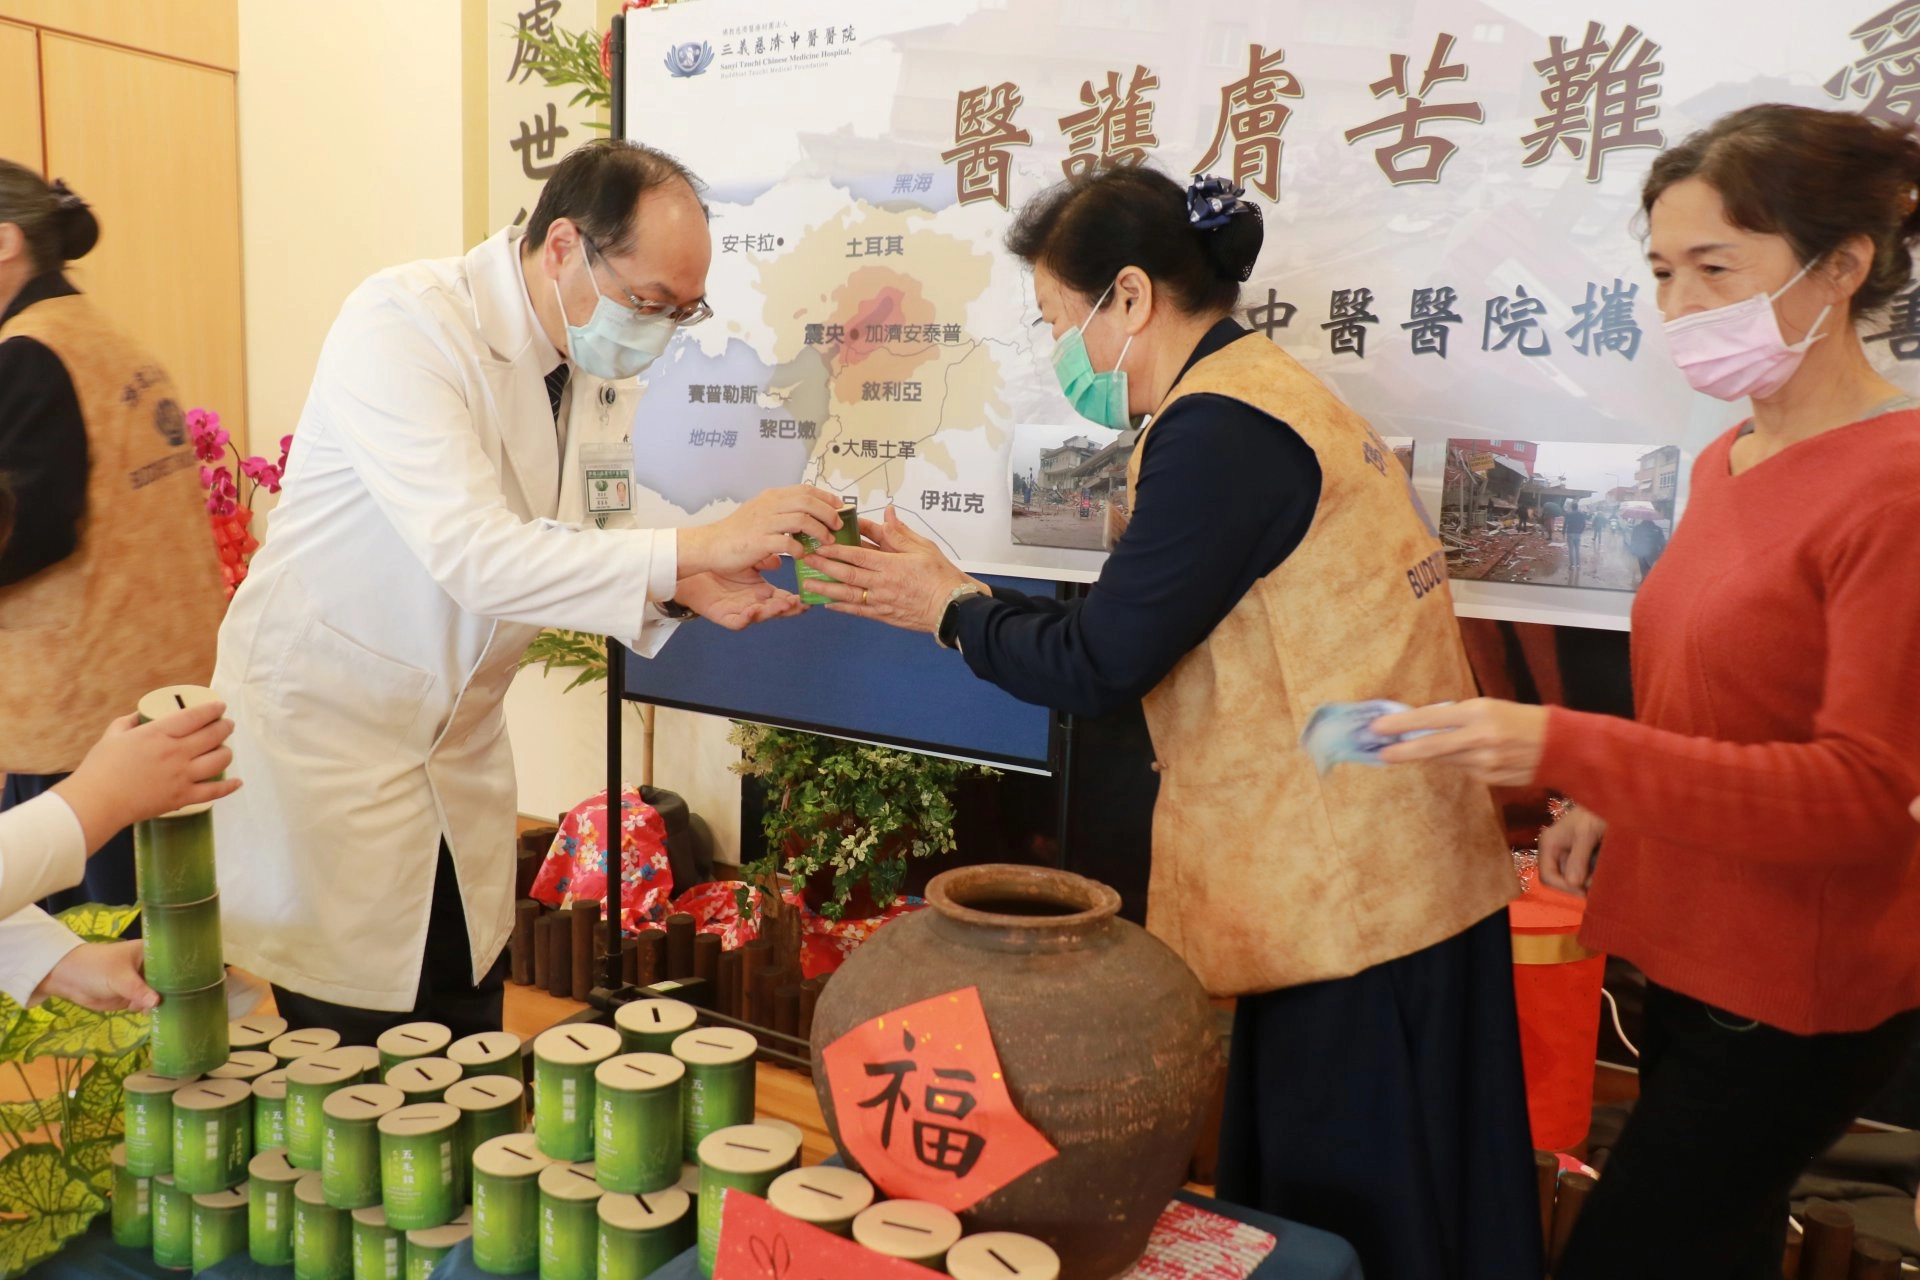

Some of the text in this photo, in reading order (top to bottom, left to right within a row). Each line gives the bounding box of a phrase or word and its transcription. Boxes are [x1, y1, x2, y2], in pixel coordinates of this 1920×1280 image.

[720, 24, 857, 56] 三義慈濟中醫醫院
[720, 61, 738, 70] Sanyi
[763, 56, 788, 65] Chinese
[790, 52, 819, 62] Medicine
[506, 0, 569, 226] 處世
[891, 172, 934, 194] 黑海
[722, 233, 775, 254] 安卡拉
[845, 235, 904, 258] 土耳其
[804, 322, 962, 346] 震央 加濟安泰普
[688, 384, 758, 405] 賽普勒斯
[688, 428, 738, 448] 地中海
[759, 419, 817, 440] 黎巴嫩
[842, 439, 917, 460] 大馬士革
[919, 489, 985, 514] 伊拉克
[857, 1028, 987, 1179] 福
